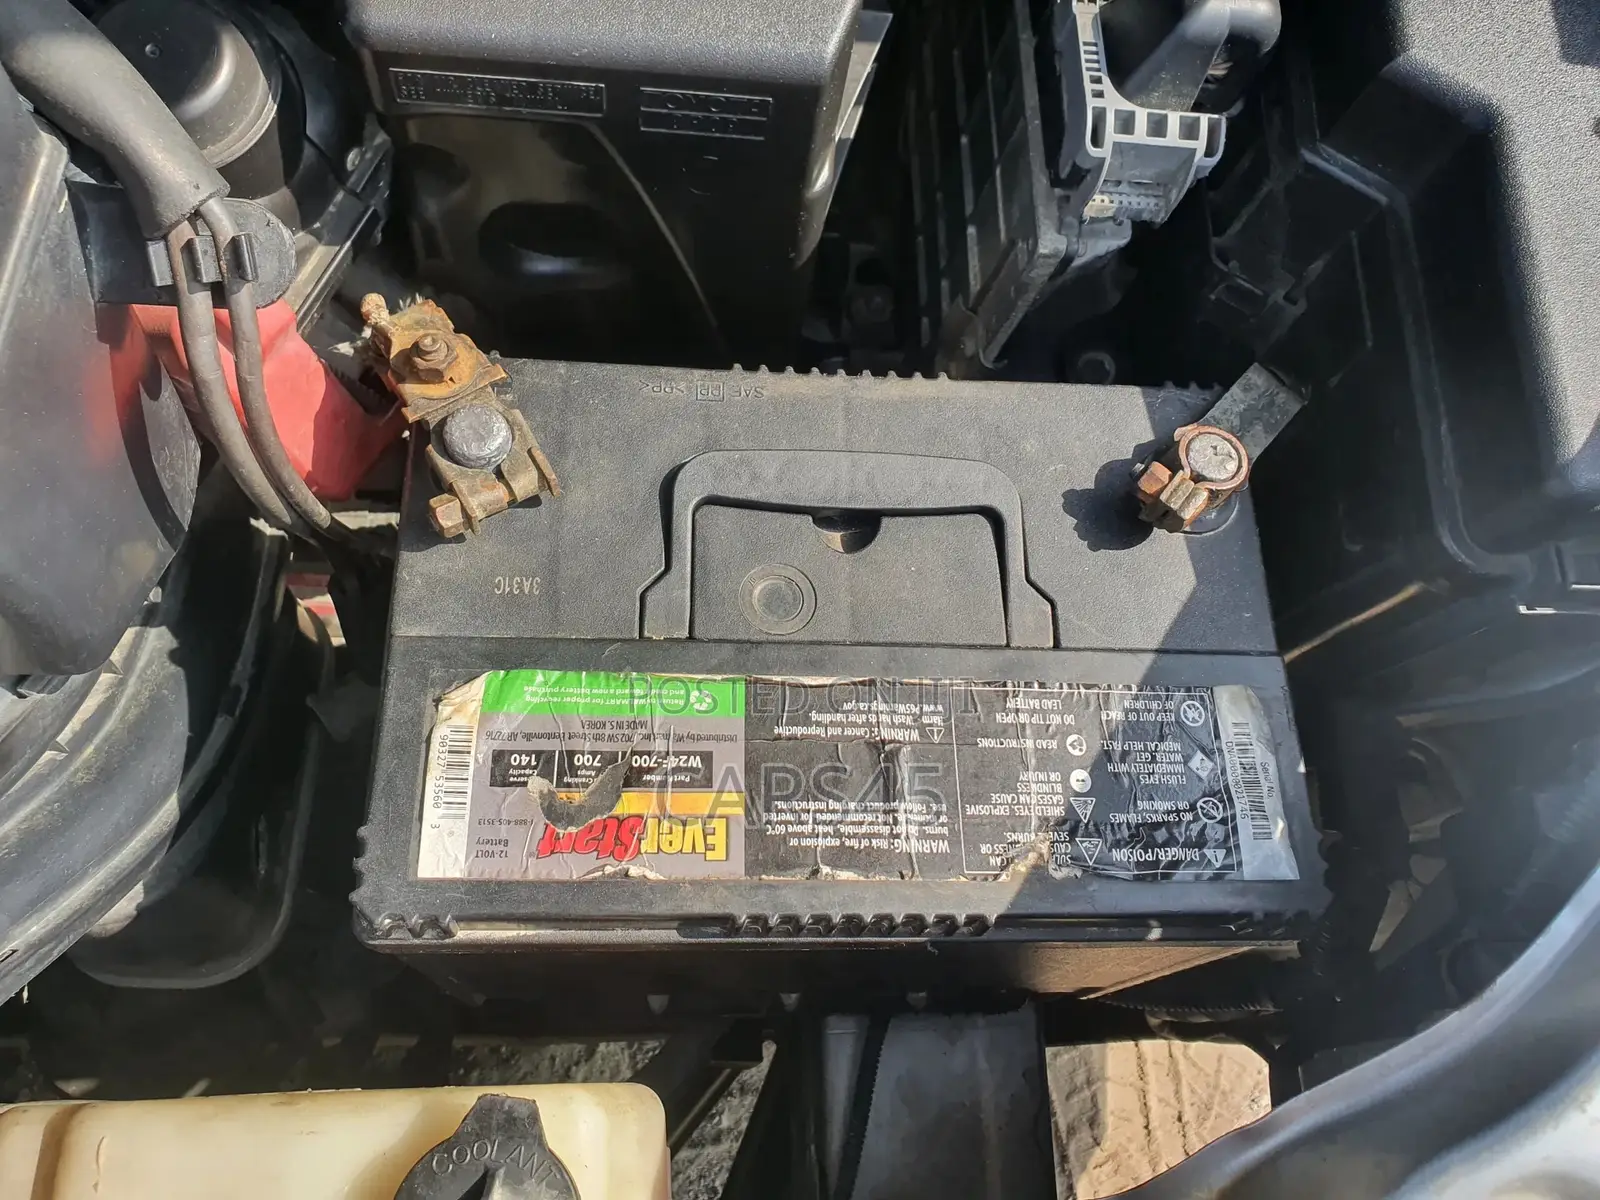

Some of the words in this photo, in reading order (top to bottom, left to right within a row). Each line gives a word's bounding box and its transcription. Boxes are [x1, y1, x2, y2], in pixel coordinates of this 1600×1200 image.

[494, 576, 541, 595] 3A31C
[523, 686, 559, 694] purchase
[560, 686, 591, 694] battery
[525, 695, 561, 703] recycling
[1005, 697, 1039, 710] BATTERY
[1040, 699, 1062, 710] LEAD
[1123, 700, 1162, 710] CHILDREN
[1163, 700, 1174, 710] OF
[808, 710, 847, 724] handling.
[847, 713, 867, 724] after
[892, 714, 914, 726] Wash
[921, 714, 944, 726] Harm
[995, 712, 1017, 724] OPEN
[1017, 712, 1030, 724] OR
[1030, 713, 1044, 725] TIP
[1046, 713, 1062, 725] NOT
[1062, 713, 1075, 725] DO
[1100, 710, 1126, 720] REACH
[1126, 712, 1137, 720] OF
[1138, 712, 1155, 721] OUT
[1156, 712, 1175, 722] KEEP
[580, 720, 607, 730] KOREA
[607, 720, 615, 730] S.
[615, 720, 624, 730] IN
[625, 720, 648, 730] MADE
[506, 731, 519, 741] AR
[519, 730, 565, 742] Bentonville,
[686, 731, 696, 743] by
[774, 725, 826, 738] Reproductive
[827, 726, 843, 737] and
[842, 727, 870, 737] Cancer
[871, 727, 920, 742] WARNING:
[567, 732, 591, 743] Street
[592, 732, 606, 743] 8th
[606, 733, 620, 743] SW
[696, 733, 738, 743] Distributed
[976, 737, 1035, 749] INSTRUCTIONS
[1035, 739, 1058, 749] READ
[1100, 740, 1122, 750] FAST.
[1122, 740, 1144, 751] HELP
[1144, 740, 1181, 752] MEDICAL
[436, 734, 449, 768] 90327
[510, 753, 537, 766] 140
[573, 753, 602, 766] 700
[1136, 752, 1152, 762] GET
[1153, 752, 1183, 762] WATER.
[508, 767, 537, 776] Capacity
[1107, 762, 1130, 772] WITH
[1130, 762, 1184, 773] IMMEDIATELY
[563, 776, 593, 784] Cranking
[673, 774, 690, 782] Part
[1018, 770, 1048, 781] INJURY
[1048, 771, 1062, 781] OR
[1139, 774, 1159, 784] EYES
[1159, 774, 1187, 784] FLUSH
[1260, 761, 1270, 785] Serial
[1266, 784, 1275, 800] No.
[432, 775, 444, 809] 53560
[1016, 781, 1062, 793] BLINDNESS
[990, 793, 1018, 804] CAUSE
[1037, 794, 1064, 804] GASES
[774, 800, 827, 811] instructions.
[828, 799, 865, 811] charging
[866, 799, 899, 812] product
[964, 804, 1010, 815] EXPLOSIVE
[1011, 804, 1034, 815] EYES.
[1036, 805, 1065, 816] SHIELD
[1136, 800, 1177, 811] SMOKING
[1177, 800, 1189, 810] OR
[477, 818, 534, 826] 1-888-405-3513
[763, 811, 799, 822] inverted
[816, 812, 876, 823] recommended
[876, 813, 893, 823] Not
[938, 814, 948, 822] or
[1109, 812, 1142, 824] FLAMES
[1142, 811, 1179, 822] SPARKS,
[1179, 812, 1194, 822] NO
[766, 824, 786, 835] 60°C
[786, 823, 813, 835] above
[814, 824, 834, 836] heat
[837, 823, 891, 836] disassemble,
[922, 825, 949, 837] burns.
[1037, 831, 1069, 841] SEVE
[475, 836, 509, 848] Battery
[789, 837, 799, 847] or
[799, 835, 841, 849] explosion
[841, 836, 859, 850] fire,
[859, 838, 870, 850] of
[871, 838, 889, 850] Risk
[890, 838, 950, 854] WARNING:
[979, 842, 993, 853] OR
[1049, 841, 1072, 852] CAUS
[475, 849, 509, 859] 12-VOLT
[1112, 848, 1200, 862] DANGER/POISON
[431, 1138, 559, 1185] COOLANT
